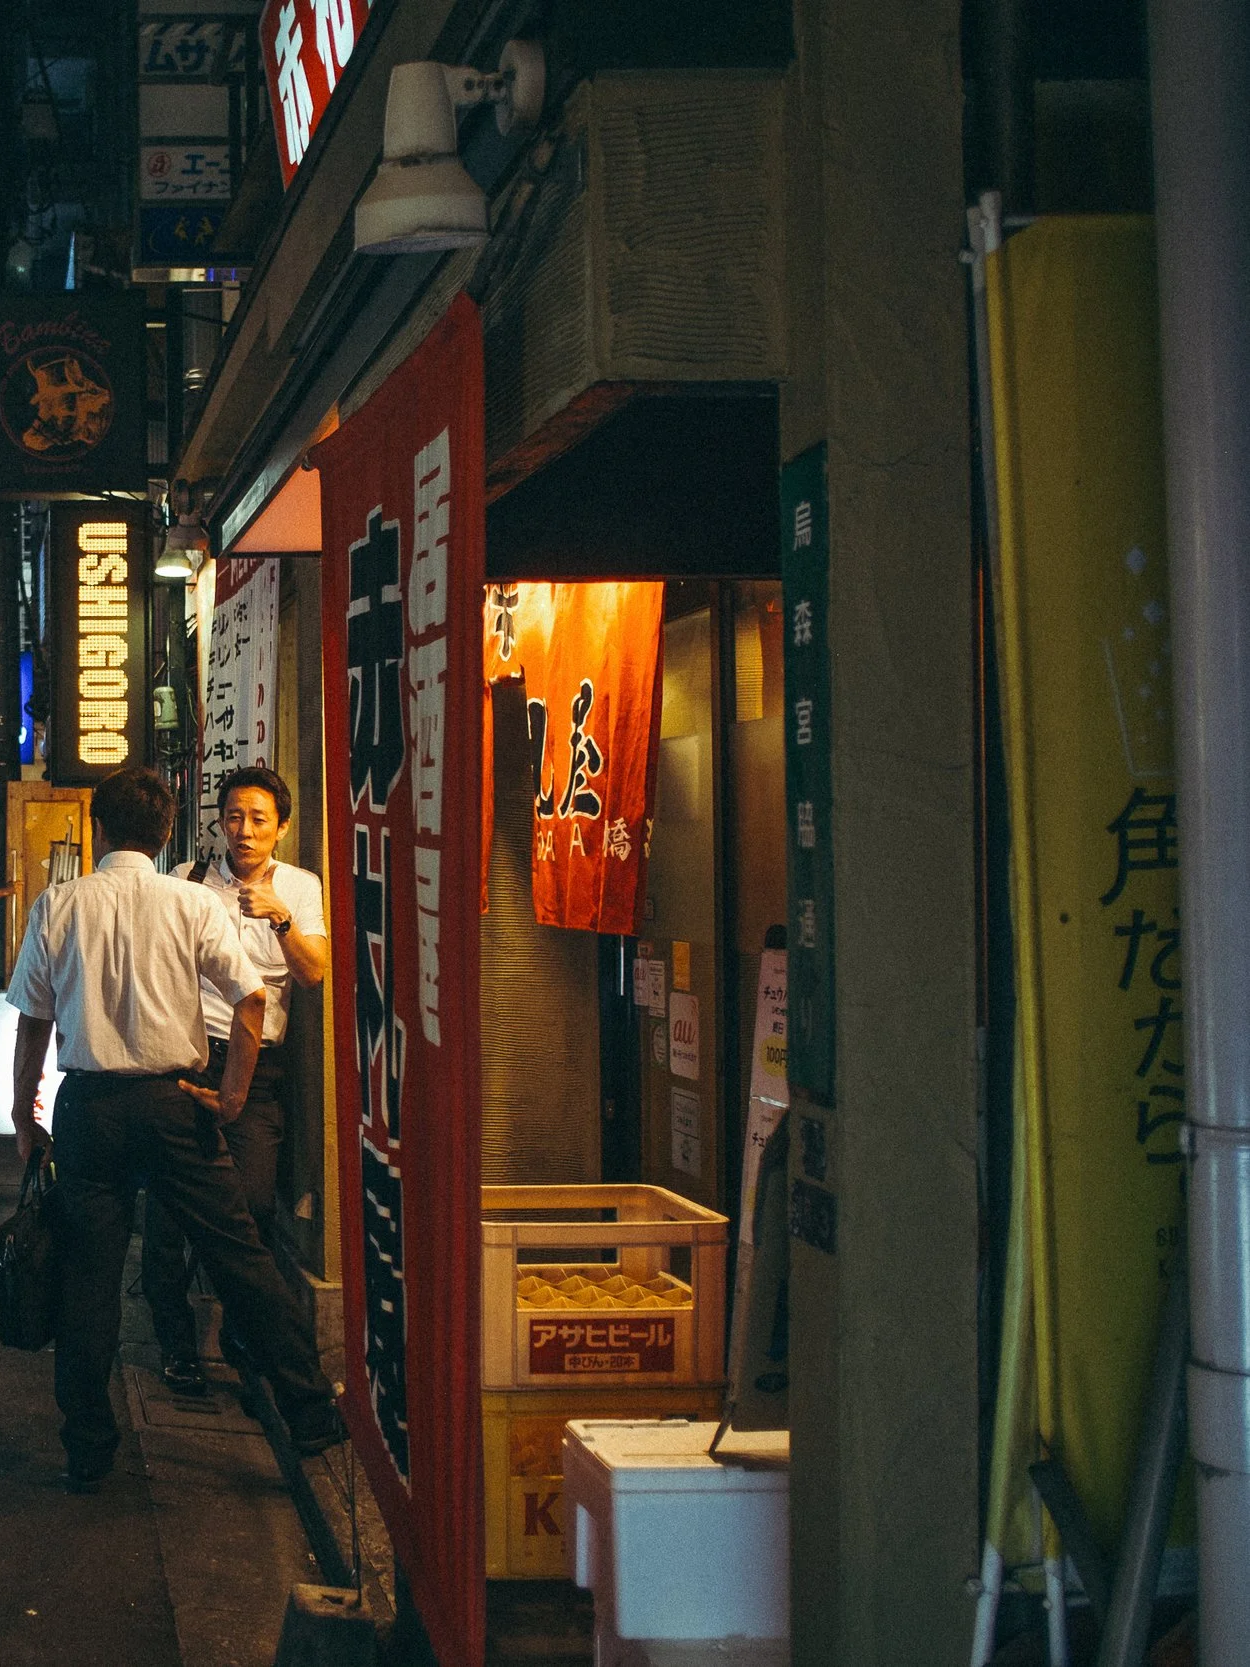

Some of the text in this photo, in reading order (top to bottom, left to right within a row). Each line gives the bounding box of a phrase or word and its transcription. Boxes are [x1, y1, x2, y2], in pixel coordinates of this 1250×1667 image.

[78, 522, 128, 764] USHIGORO
[673, 1019, 696, 1046] au
[532, 1322, 673, 1349] アサヒビール
